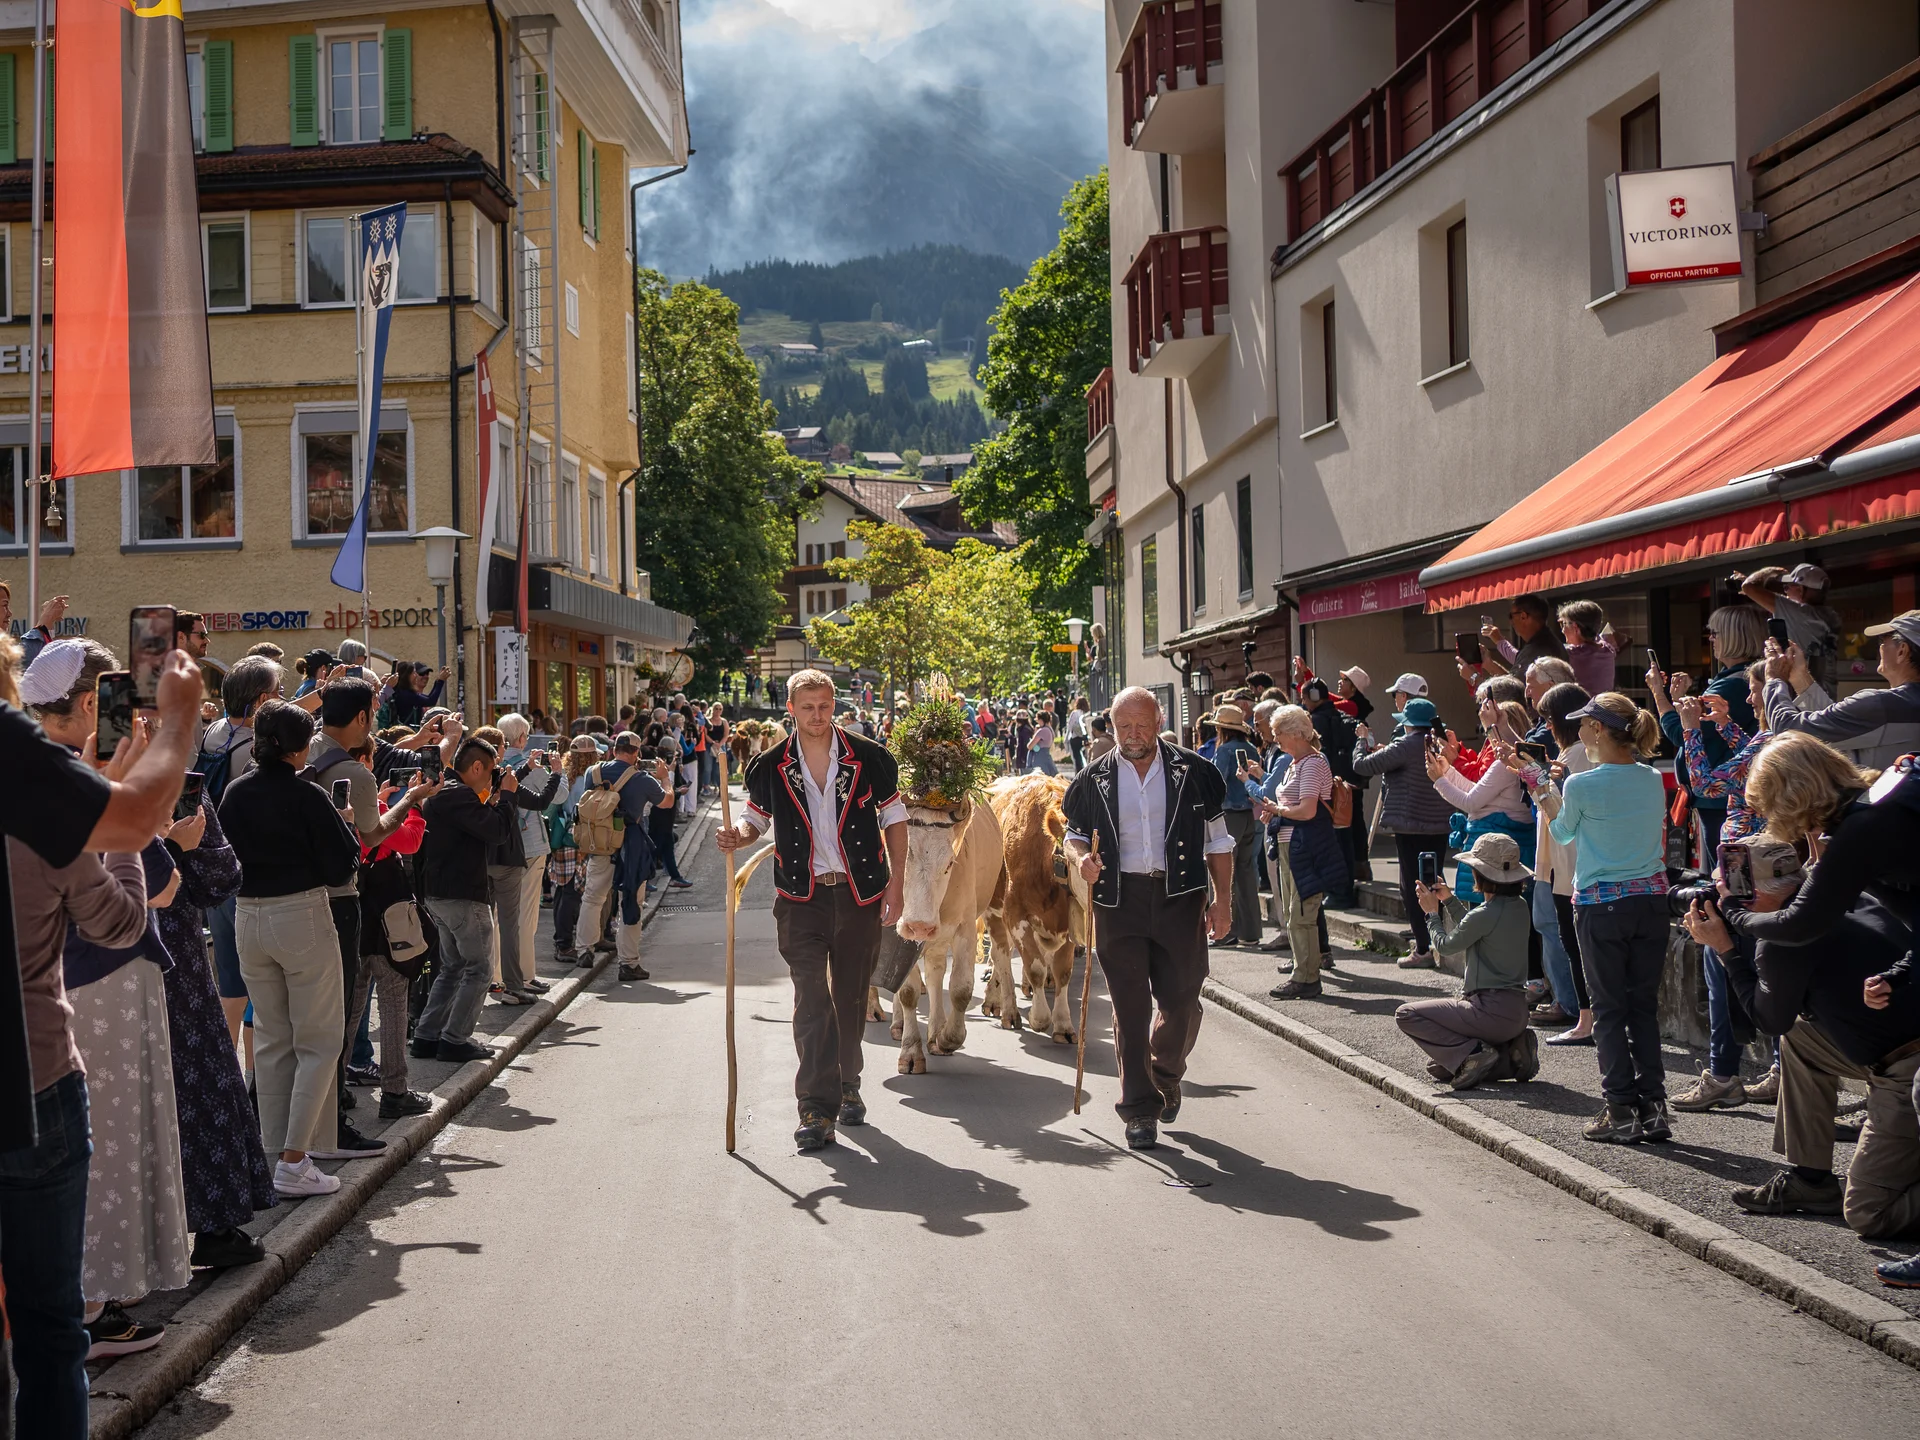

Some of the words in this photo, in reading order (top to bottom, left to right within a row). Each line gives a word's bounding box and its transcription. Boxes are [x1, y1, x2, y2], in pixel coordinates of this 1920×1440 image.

[1629, 223, 1732, 243] VICTORINOX
[1650, 271, 1683, 280] OFFICIAL
[1685, 267, 1719, 277] PARTNER
[201, 611, 309, 631] TERSPORT
[324, 602, 438, 636] alpiaSPOR
